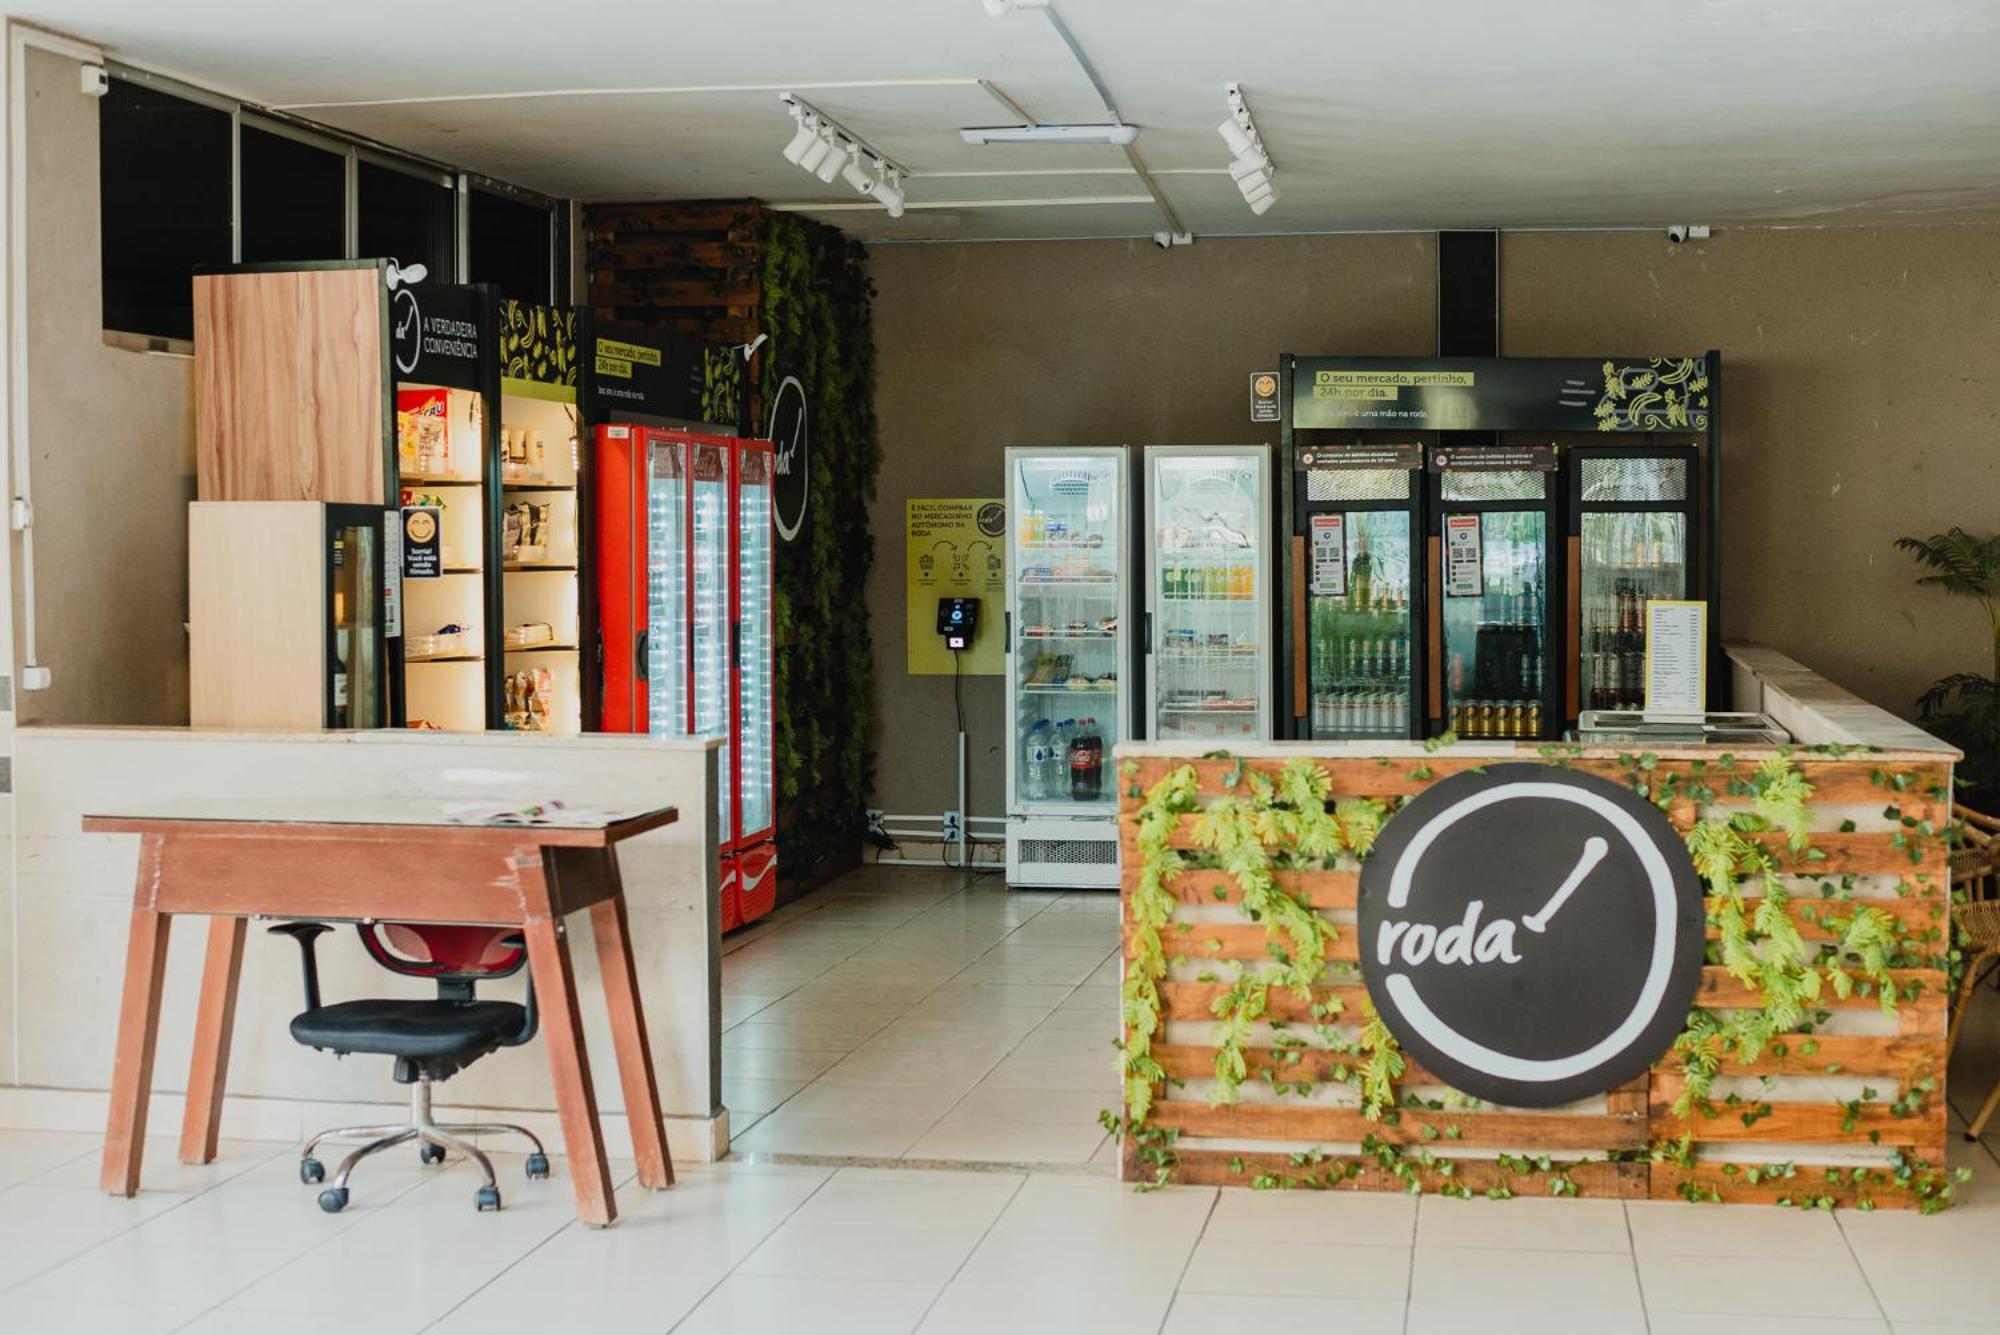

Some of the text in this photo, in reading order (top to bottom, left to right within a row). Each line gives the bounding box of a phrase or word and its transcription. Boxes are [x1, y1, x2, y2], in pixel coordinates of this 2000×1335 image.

[424, 316, 478, 339] A VERDADEIRA
[423, 337, 478, 358] CONVENIÊNCIA
[1320, 373, 1330, 383] O
[1356, 373, 1411, 385] mercado,
[1413, 373, 1468, 385] pertinho,
[1320, 388, 1390, 400] 24h por dia.
[1361, 410, 1378, 418] uma
[1377, 900, 1522, 966] roda
